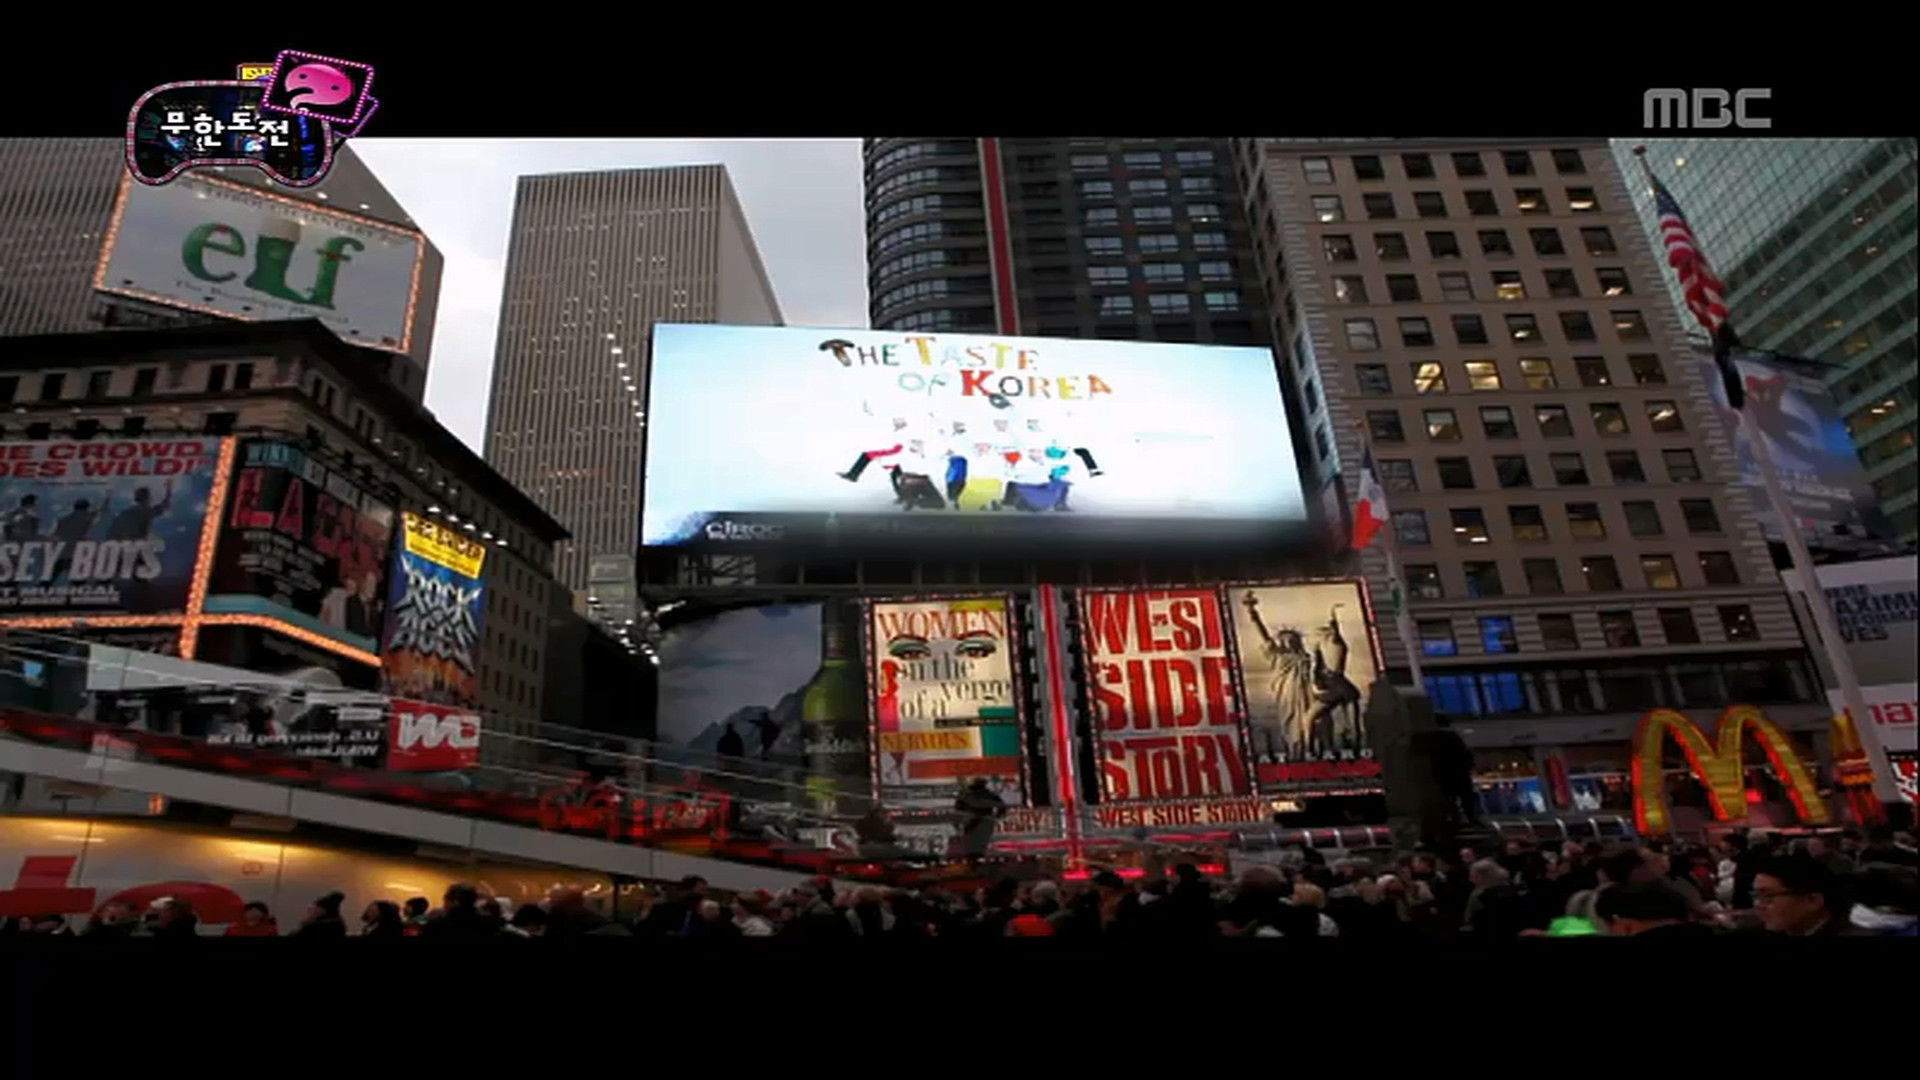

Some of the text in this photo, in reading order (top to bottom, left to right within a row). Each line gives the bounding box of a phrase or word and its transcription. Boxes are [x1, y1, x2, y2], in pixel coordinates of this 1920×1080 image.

[820, 336, 1040, 371] THE TASTE
[898, 369, 1113, 403] OF KOREA
[48, 441, 204, 459] CROWD
[68, 540, 166, 581] BOYS
[878, 607, 1005, 640] WOMEN
[1089, 591, 1222, 654] WEST
[932, 651, 976, 681] the
[901, 689, 949, 720] of a
[940, 679, 1010, 704] verge
[1092, 657, 1237, 731] SIDE
[882, 731, 970, 752] NERVOUS
[1101, 734, 1252, 802] STORY
[1099, 801, 1262, 828] WEST SIDE STORY
